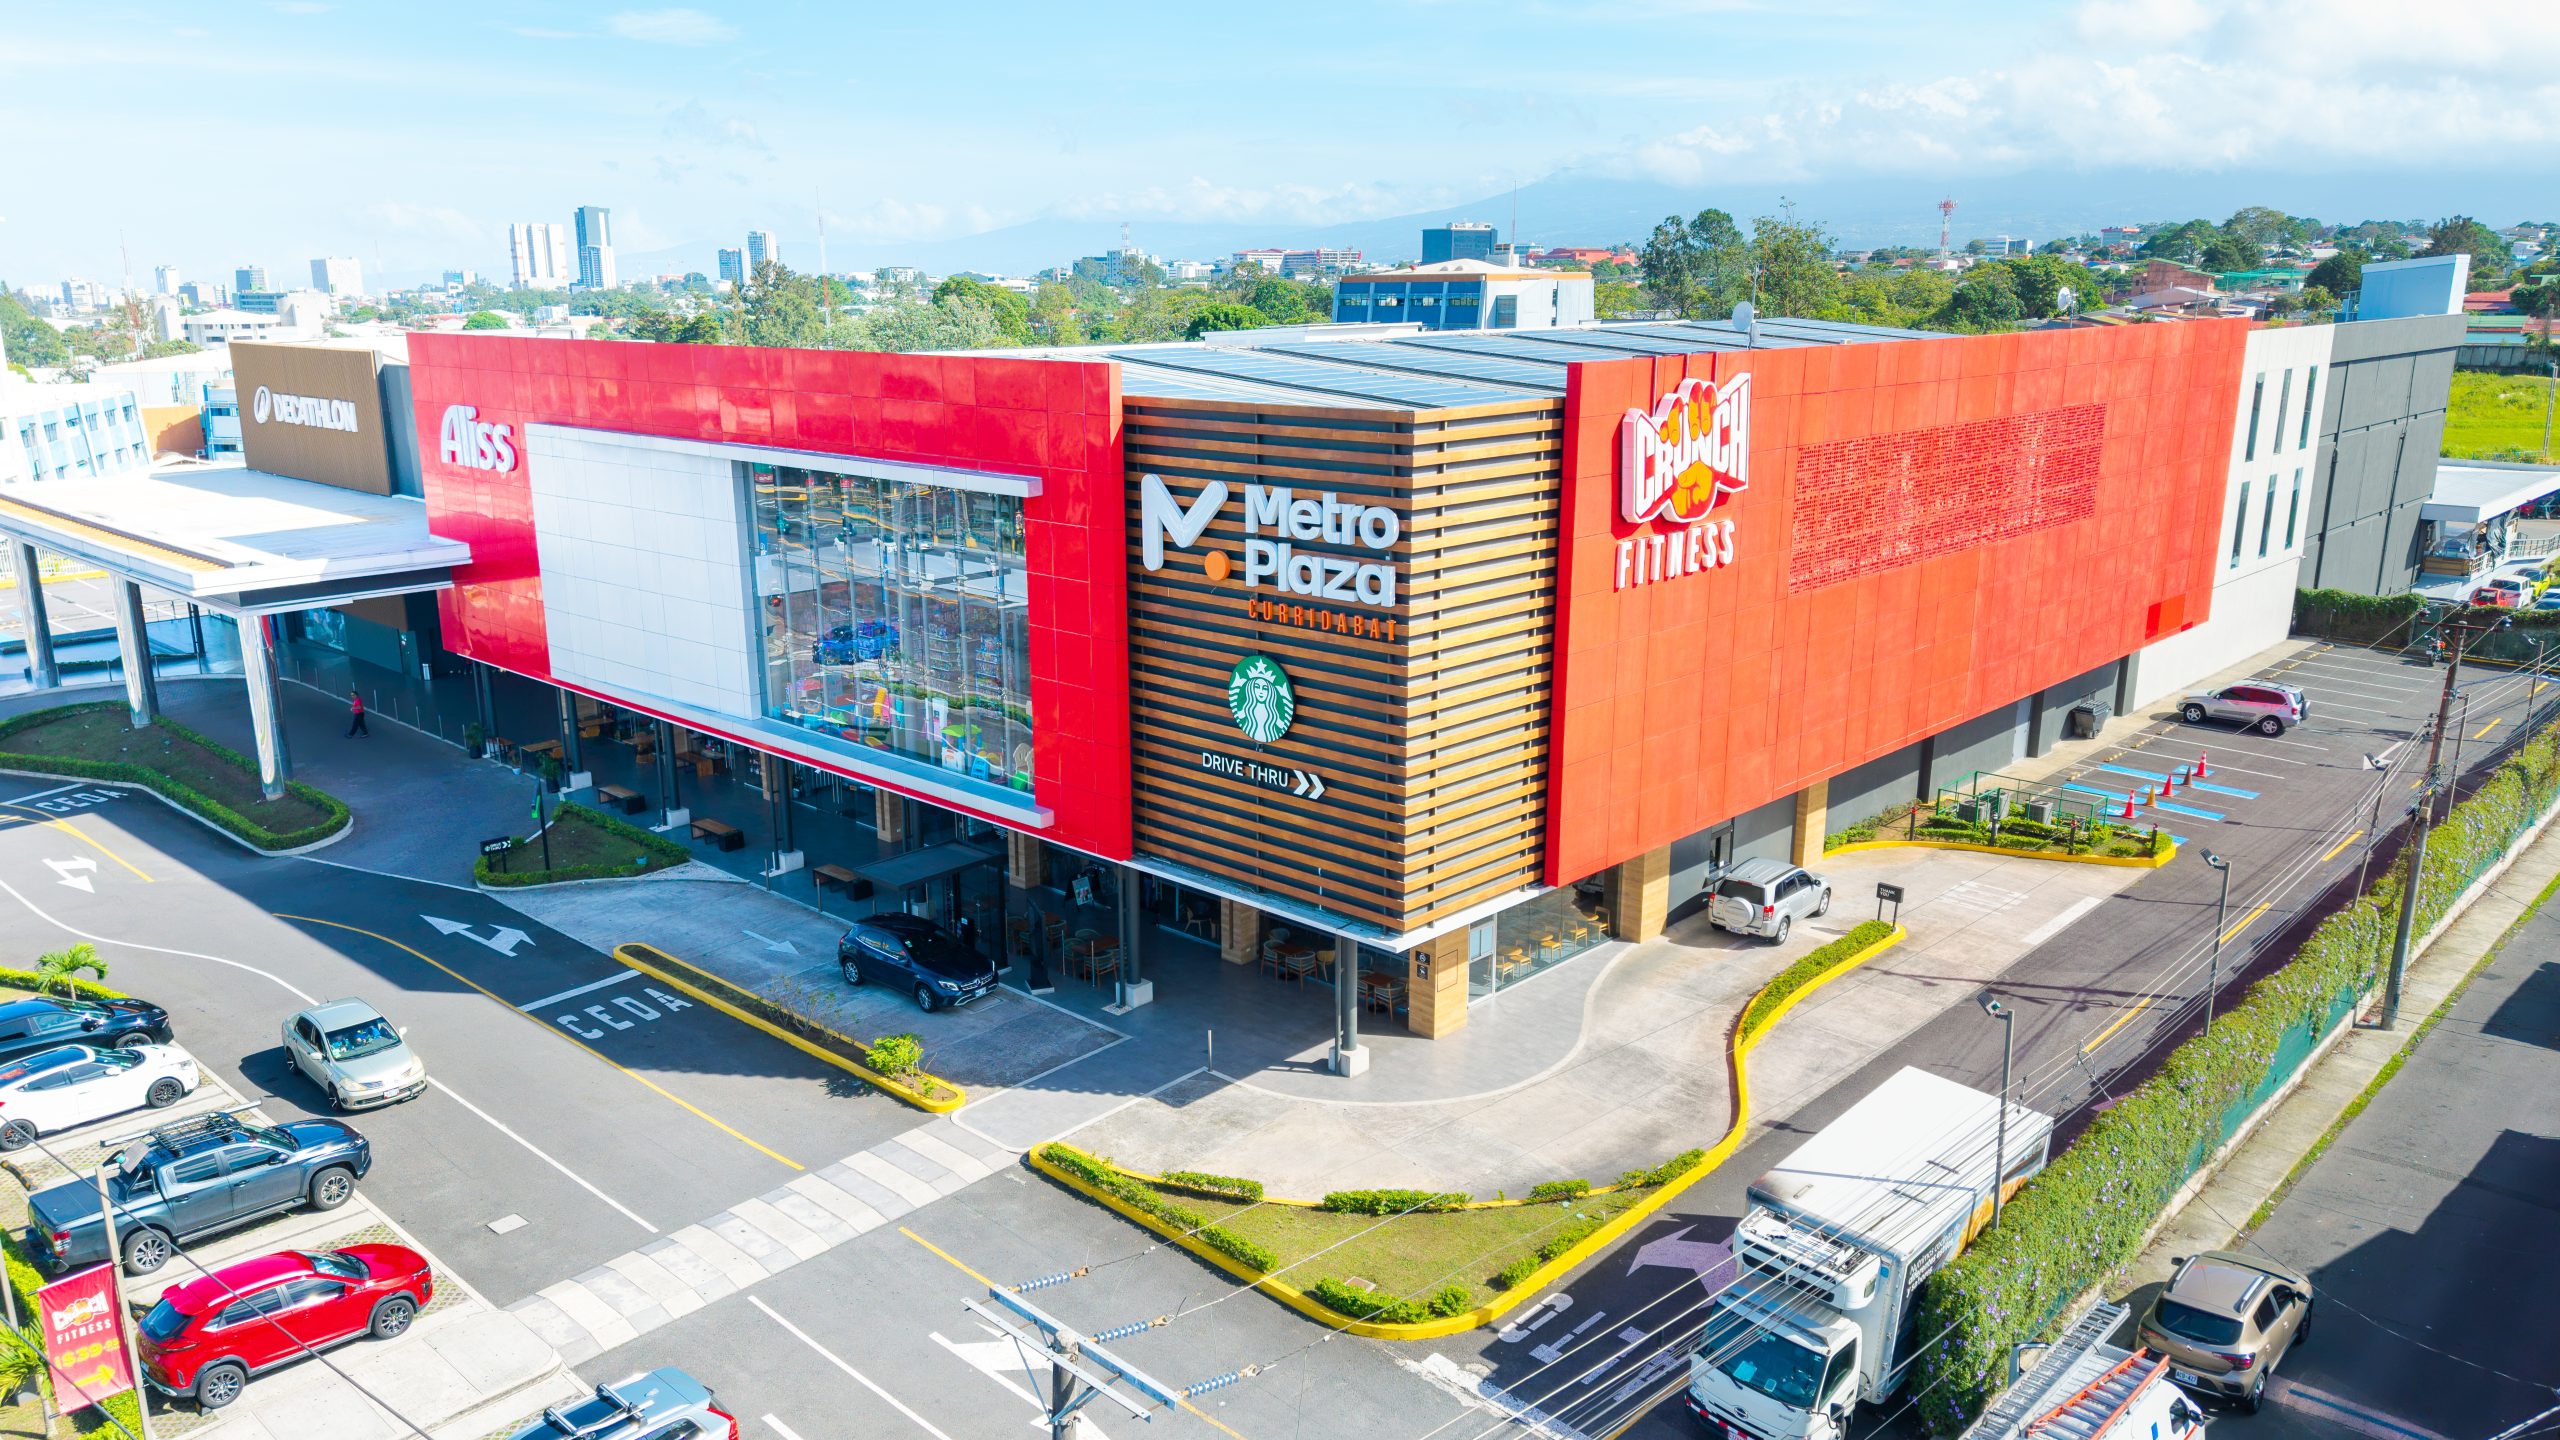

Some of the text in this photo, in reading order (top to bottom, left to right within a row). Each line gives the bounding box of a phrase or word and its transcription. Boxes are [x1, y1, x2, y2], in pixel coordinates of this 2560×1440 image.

[273, 392, 358, 433] DECATHLON
[441, 404, 516, 473] Aliss
[1635, 380, 1750, 517] CRUNCH
[1244, 484, 1399, 550] Metro
[1245, 540, 1396, 608] Plaza
[1616, 520, 1735, 588] FITNESS
[1248, 598, 1397, 641] CURRIDABAT
[1202, 752, 1289, 788] DRIVE THRU
[35, 788, 129, 812] CEDA
[1880, 887, 1896, 895] THANK
[557, 987, 694, 1040] CEDA
[56, 1319, 112, 1345] FITNESS
